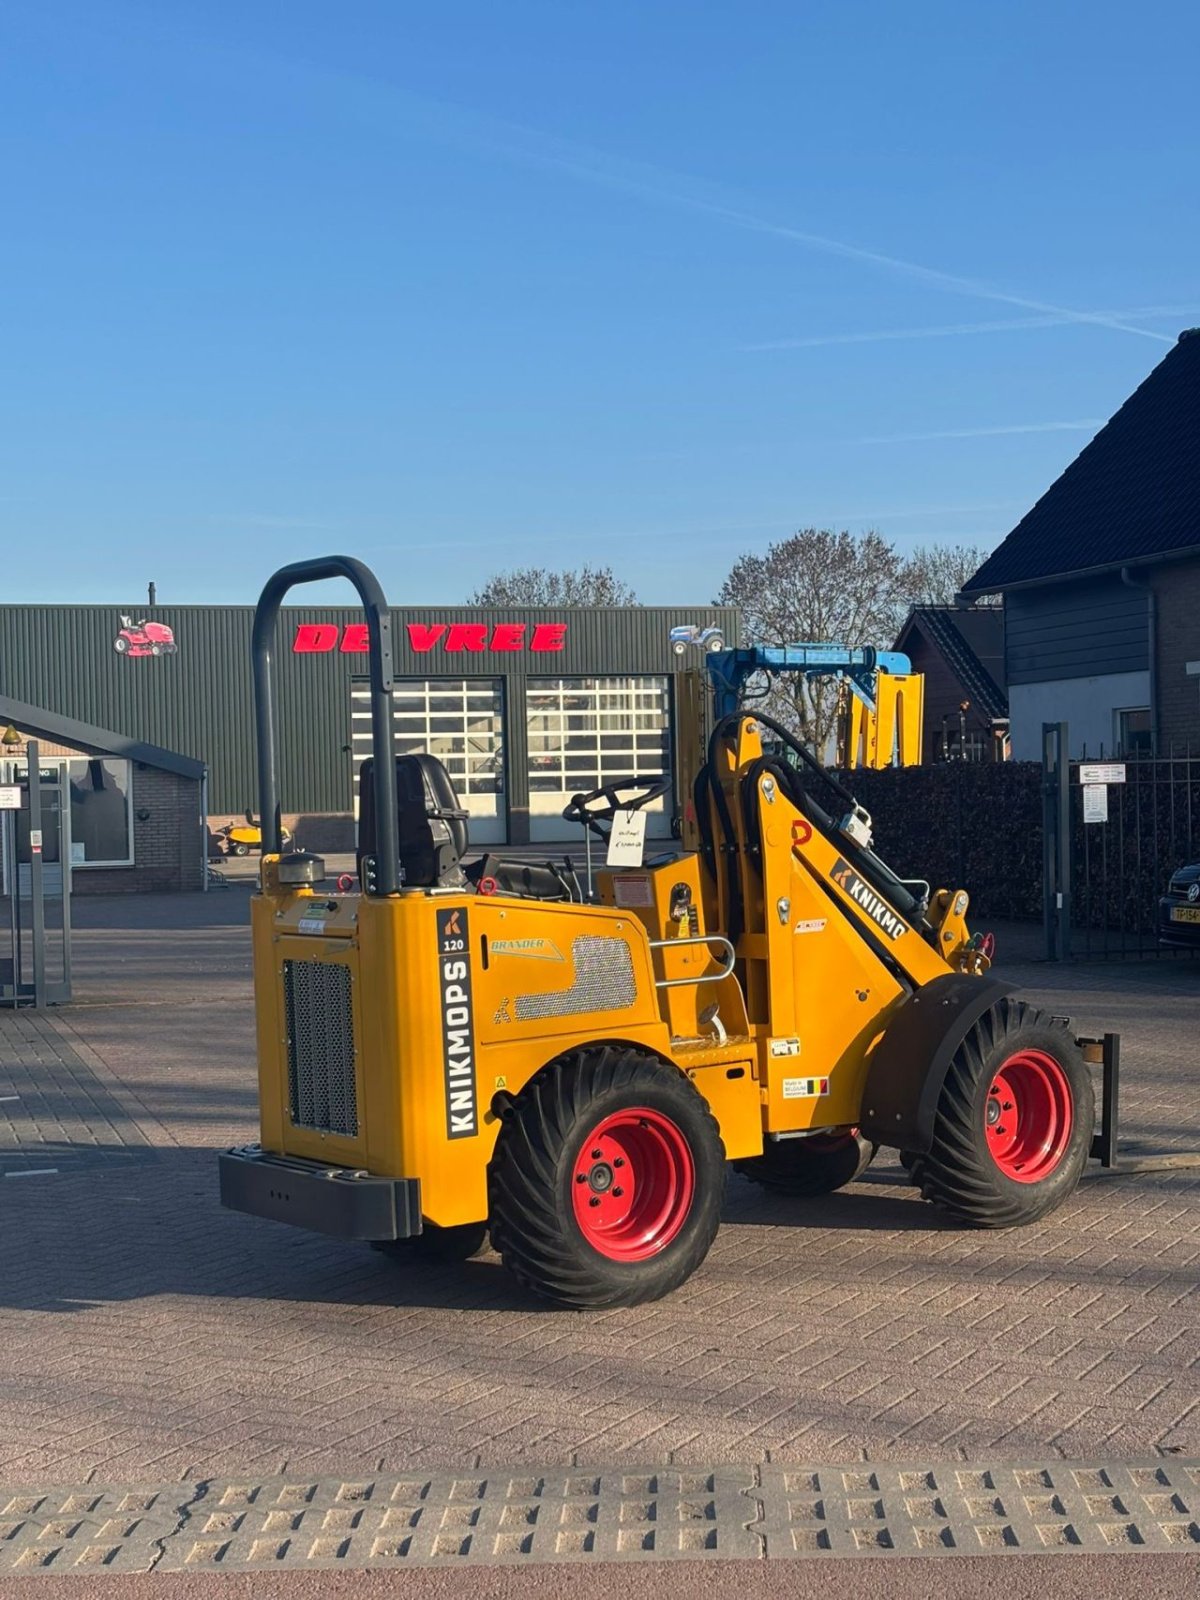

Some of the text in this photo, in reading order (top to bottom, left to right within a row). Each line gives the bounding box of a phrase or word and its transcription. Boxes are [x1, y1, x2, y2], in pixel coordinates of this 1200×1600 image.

[293, 623, 568, 653] DE VREE
[443, 939, 465, 951] 120
[491, 939, 545, 951] BRANDER
[444, 961, 474, 1133] KNIKMOPS
